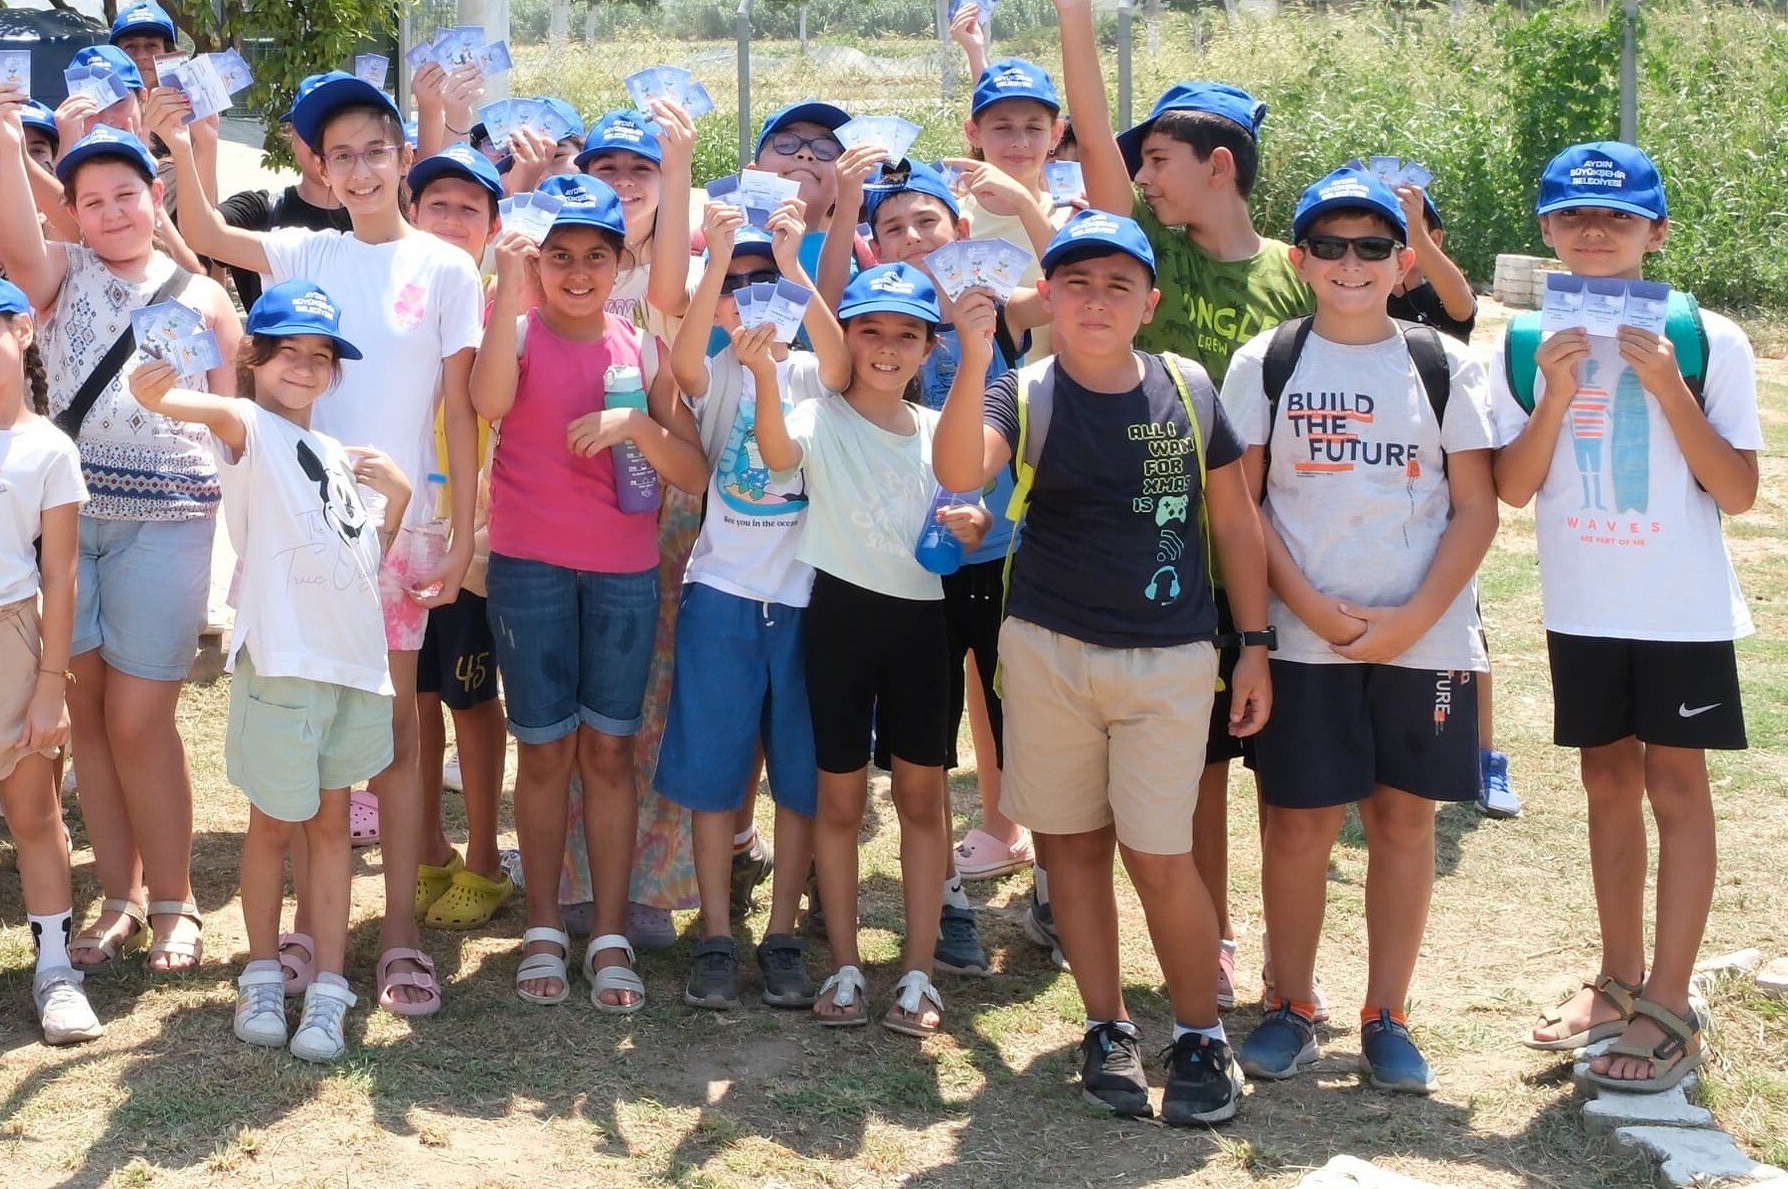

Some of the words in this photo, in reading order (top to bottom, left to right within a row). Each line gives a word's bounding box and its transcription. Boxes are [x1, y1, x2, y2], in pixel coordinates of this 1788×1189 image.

[1584, 160, 1613, 169] AYDIN
[1198, 334, 1228, 356] CREW
[1288, 392, 1374, 414] BUILD
[1128, 423, 1165, 440] ALL
[1167, 421, 1176, 437] I
[1288, 415, 1346, 437] THE
[1144, 457, 1183, 476] FOR
[1133, 496, 1153, 512] IS
[736, 519, 751, 528] you
[762, 518, 775, 527] the
[455, 652, 490, 692] 45
